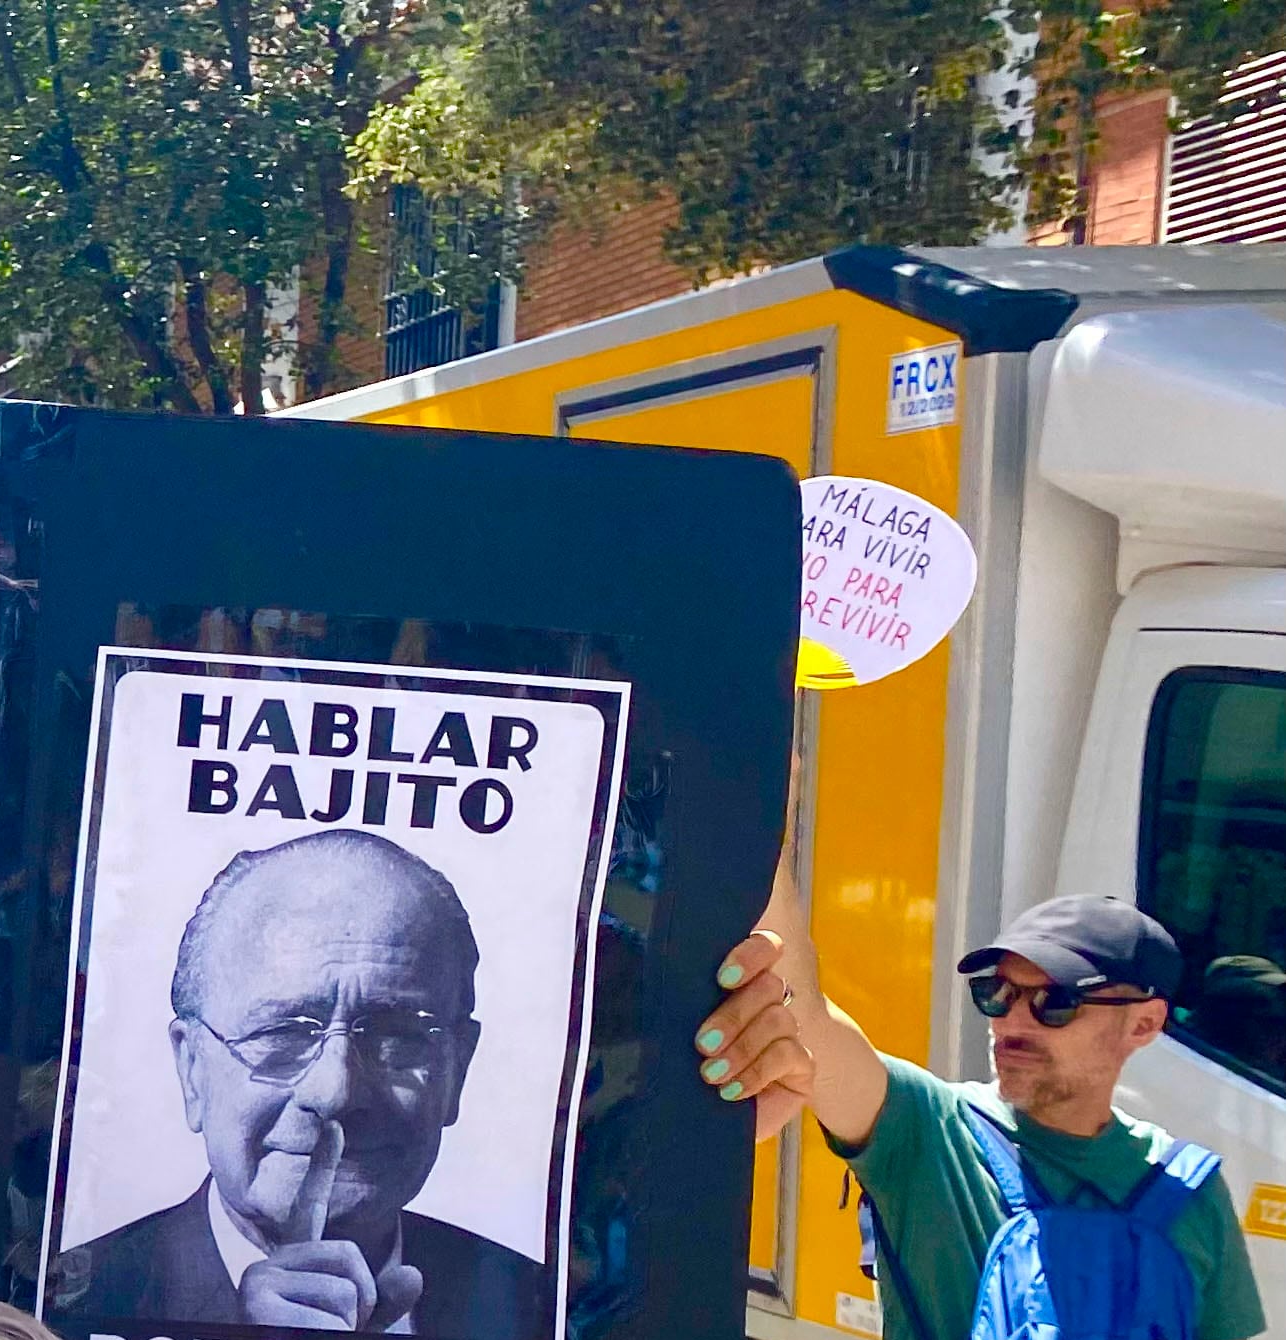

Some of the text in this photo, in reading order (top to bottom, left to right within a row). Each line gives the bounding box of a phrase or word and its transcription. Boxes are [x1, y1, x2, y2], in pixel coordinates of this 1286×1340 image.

[892, 353, 957, 398] FRCX
[802, 515, 847, 551] ARA
[820, 484, 931, 543] MÁLAGA
[842, 567, 904, 609] PARA
[175, 692, 539, 773] HABLAR
[186, 758, 515, 834] BAJITO
